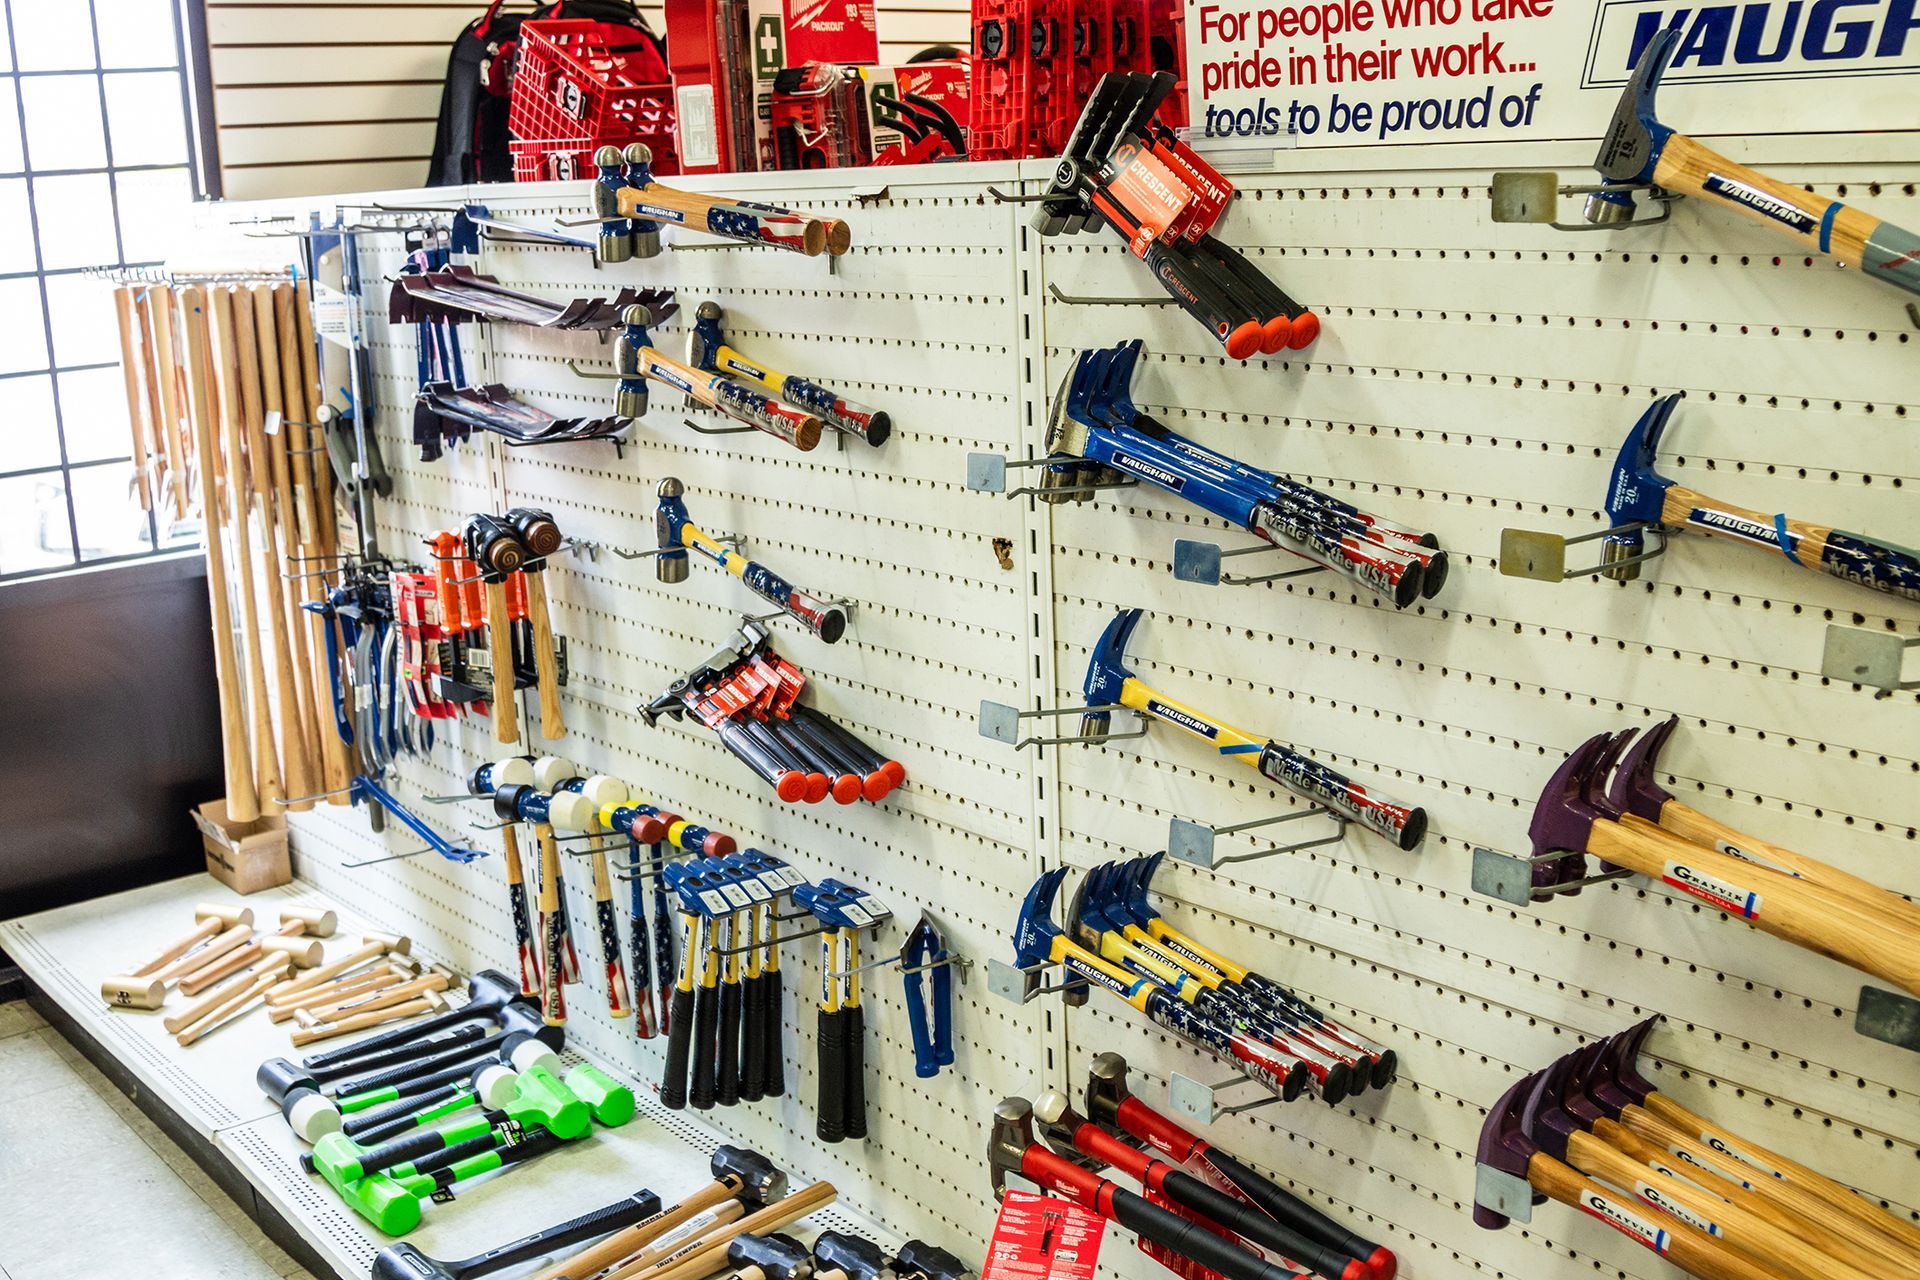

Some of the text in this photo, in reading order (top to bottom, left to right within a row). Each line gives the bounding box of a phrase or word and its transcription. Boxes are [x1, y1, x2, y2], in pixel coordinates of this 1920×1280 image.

[811, 21, 845, 32] PACKOUT
[1200, 0, 1551, 48] For people who take
[1202, 32, 1537, 100] pride in their work...
[1205, 83, 1543, 140] tools to be proud of
[1131, 159, 1183, 211] CRESCENT
[1719, 182, 1802, 224] VAUGHAN
[1169, 274, 1199, 304] CRESCENT
[776, 412, 795, 432] USA
[1121, 456, 1176, 483] VAUGHAN
[1625, 489, 1637, 504] 20
[1264, 511, 1391, 592] Made in the USA
[1829, 560, 1889, 592] Made
[1156, 704, 1209, 733] VAUGHAN
[1272, 759, 1396, 834] Made in the USA
[1673, 866, 1743, 902] GRAYVIK
[1140, 945, 1191, 978] VAUGHAN
[1168, 941, 1218, 974] VAUGHAN
[1072, 960, 1125, 992] VAUGHAN
[1161, 1010, 1278, 1086] Made in the USA
[1590, 1196, 1654, 1238] GRAYVIK
[1644, 1187, 1706, 1231] GRAYVIK
[656, 1241, 703, 1269] TRUE TEMPER
